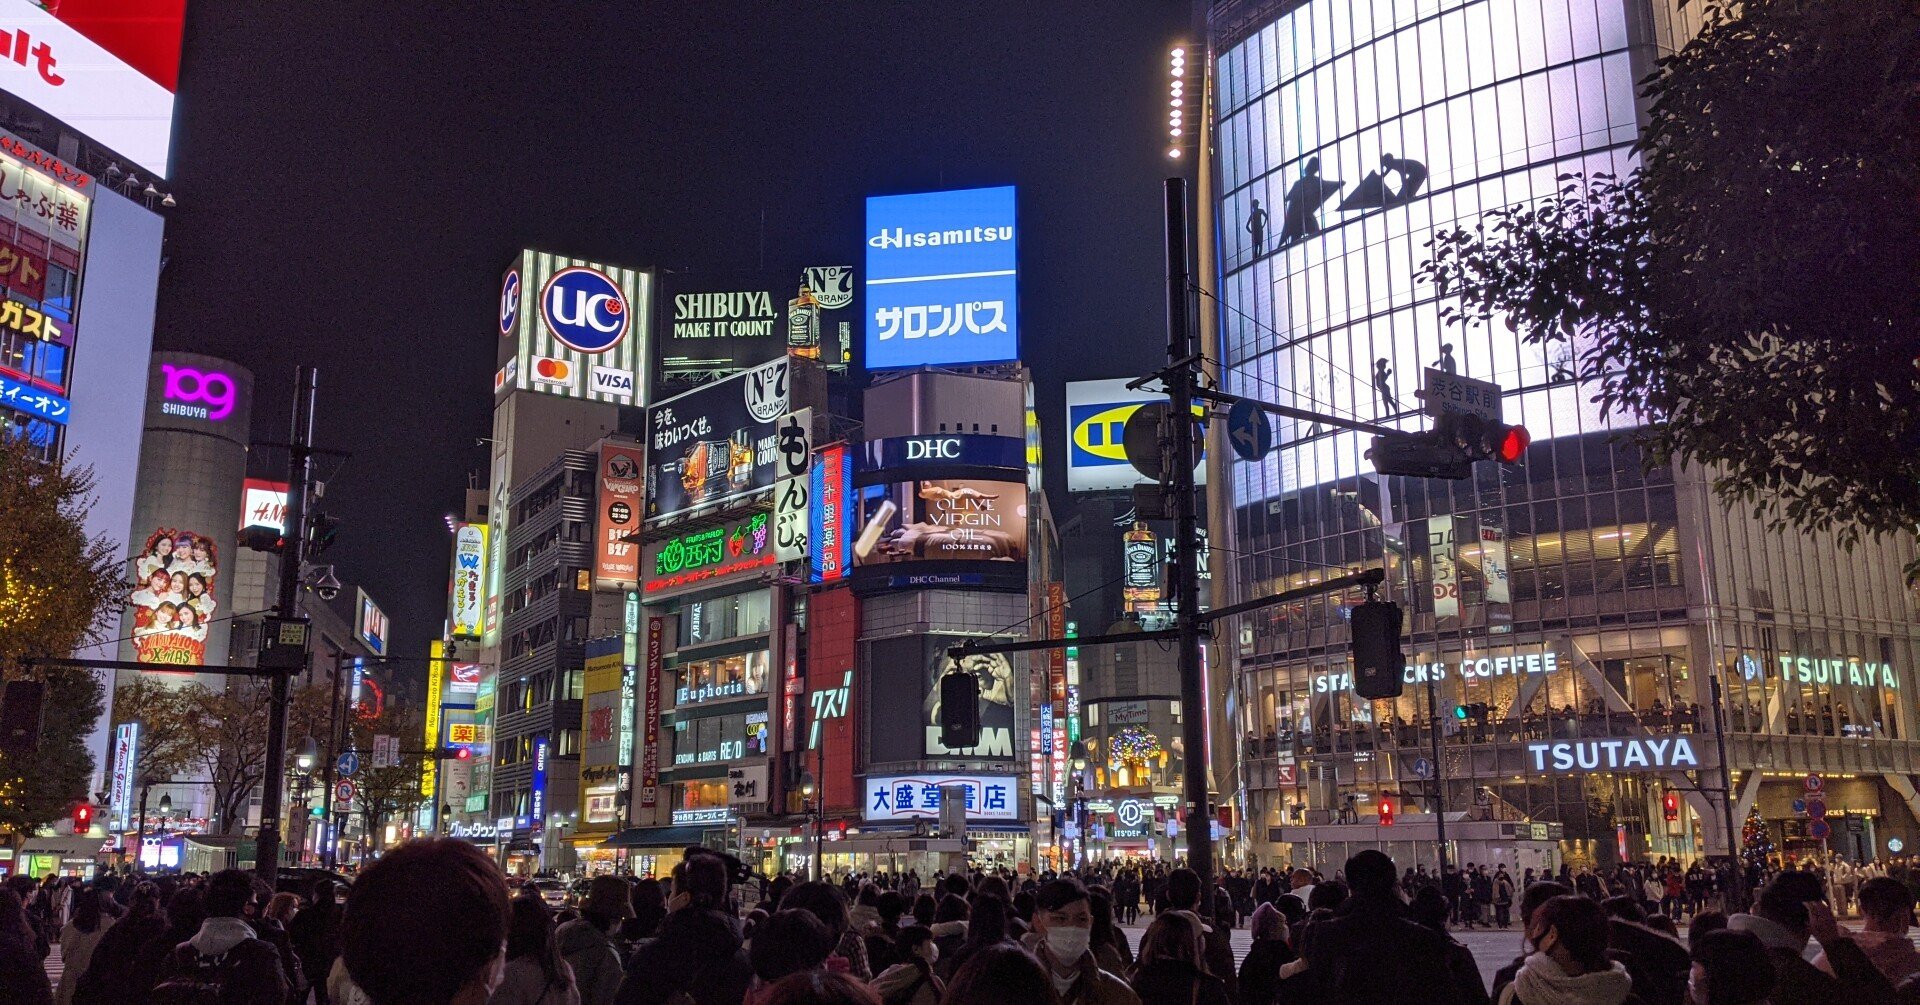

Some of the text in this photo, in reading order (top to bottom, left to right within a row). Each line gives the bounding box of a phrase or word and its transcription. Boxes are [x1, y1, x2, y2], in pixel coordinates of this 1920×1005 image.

[869, 226, 1013, 249] Hisamitsu
[675, 291, 778, 320] SHIBUYA,
[818, 294, 849, 303] BRAND
[674, 322, 711, 339] MAKE
[714, 321, 729, 337] IT
[730, 320, 774, 337] COUNT
[875, 300, 1007, 341] サロンパス
[537, 376, 567, 386] mastercard
[594, 371, 632, 390] VISA
[162, 364, 235, 420] 109
[1432, 377, 1496, 410] 渋谷駅前
[162, 402, 207, 419] SHIBUYA
[654, 407, 677, 430] 今を、
[654, 416, 712, 451] 味わいつくせ。
[758, 446, 778, 467] COUN
[906, 439, 961, 460] DHC
[777, 415, 808, 554] もんじゃ
[253, 501, 289, 524] H&M
[936, 498, 995, 511] OLIVE
[930, 513, 1000, 526] VIRGIN
[949, 527, 984, 540] OIL
[607, 543, 631, 556] B2F
[909, 575, 960, 584] DHC Channel
[1052, 586, 1061, 660] クスリのことら
[1460, 652, 1557, 678] COFFEE
[1779, 656, 1896, 689] TSUTAYA
[680, 681, 743, 703] Euphoria
[453, 725, 473, 742] 薬
[537, 743, 546, 771] MIZUHO
[720, 740, 742, 761] RE/D
[1528, 738, 1698, 771] TSUTAYA
[873, 784, 1007, 811] 大盛堂書店
[450, 820, 496, 838] グルメタウン
